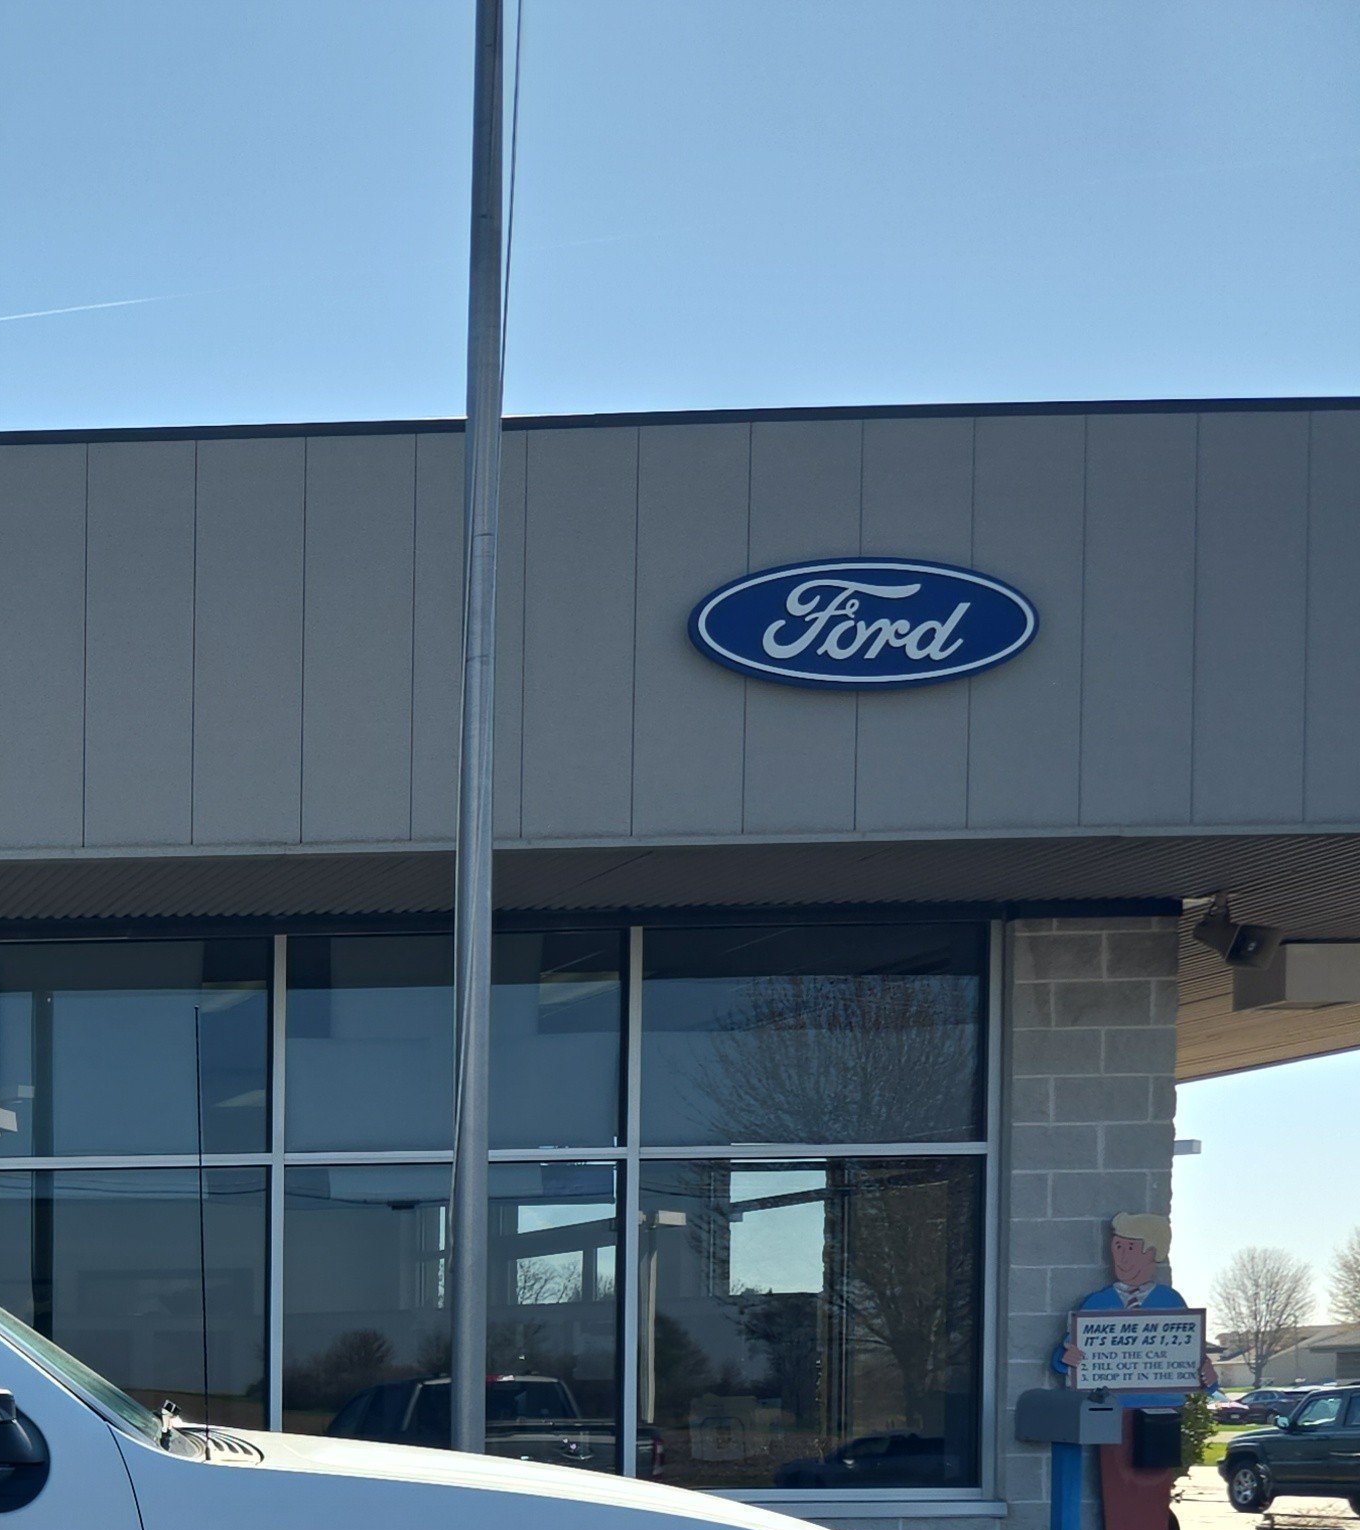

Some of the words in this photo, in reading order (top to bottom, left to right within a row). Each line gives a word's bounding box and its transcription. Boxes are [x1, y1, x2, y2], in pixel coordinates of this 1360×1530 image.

[762, 578, 972, 661] Ford
[1083, 1323, 1116, 1334] MAKE
[1120, 1323, 1138, 1333] ME
[1142, 1323, 1158, 1333] AN
[1162, 1322, 1196, 1333] OFFER
[1084, 1335, 1107, 1347] IT'S
[1111, 1335, 1138, 1346] EASY
[1141, 1335, 1157, 1345] AS
[1092, 1351, 1118, 1360] FIND
[1121, 1351, 1142, 1360] THE
[1145, 1350, 1168, 1359] CAR
[1092, 1362, 1113, 1371] FILL
[1116, 1361, 1139, 1371] OUT
[1143, 1361, 1163, 1370] THE
[1166, 1360, 1196, 1369] FORM
[1092, 1372, 1120, 1381] DROP
[1123, 1372, 1134, 1381] IT
[1137, 1372, 1150, 1380] IN
[1154, 1371, 1173, 1380] THE
[1177, 1371, 1197, 1380] BOX
